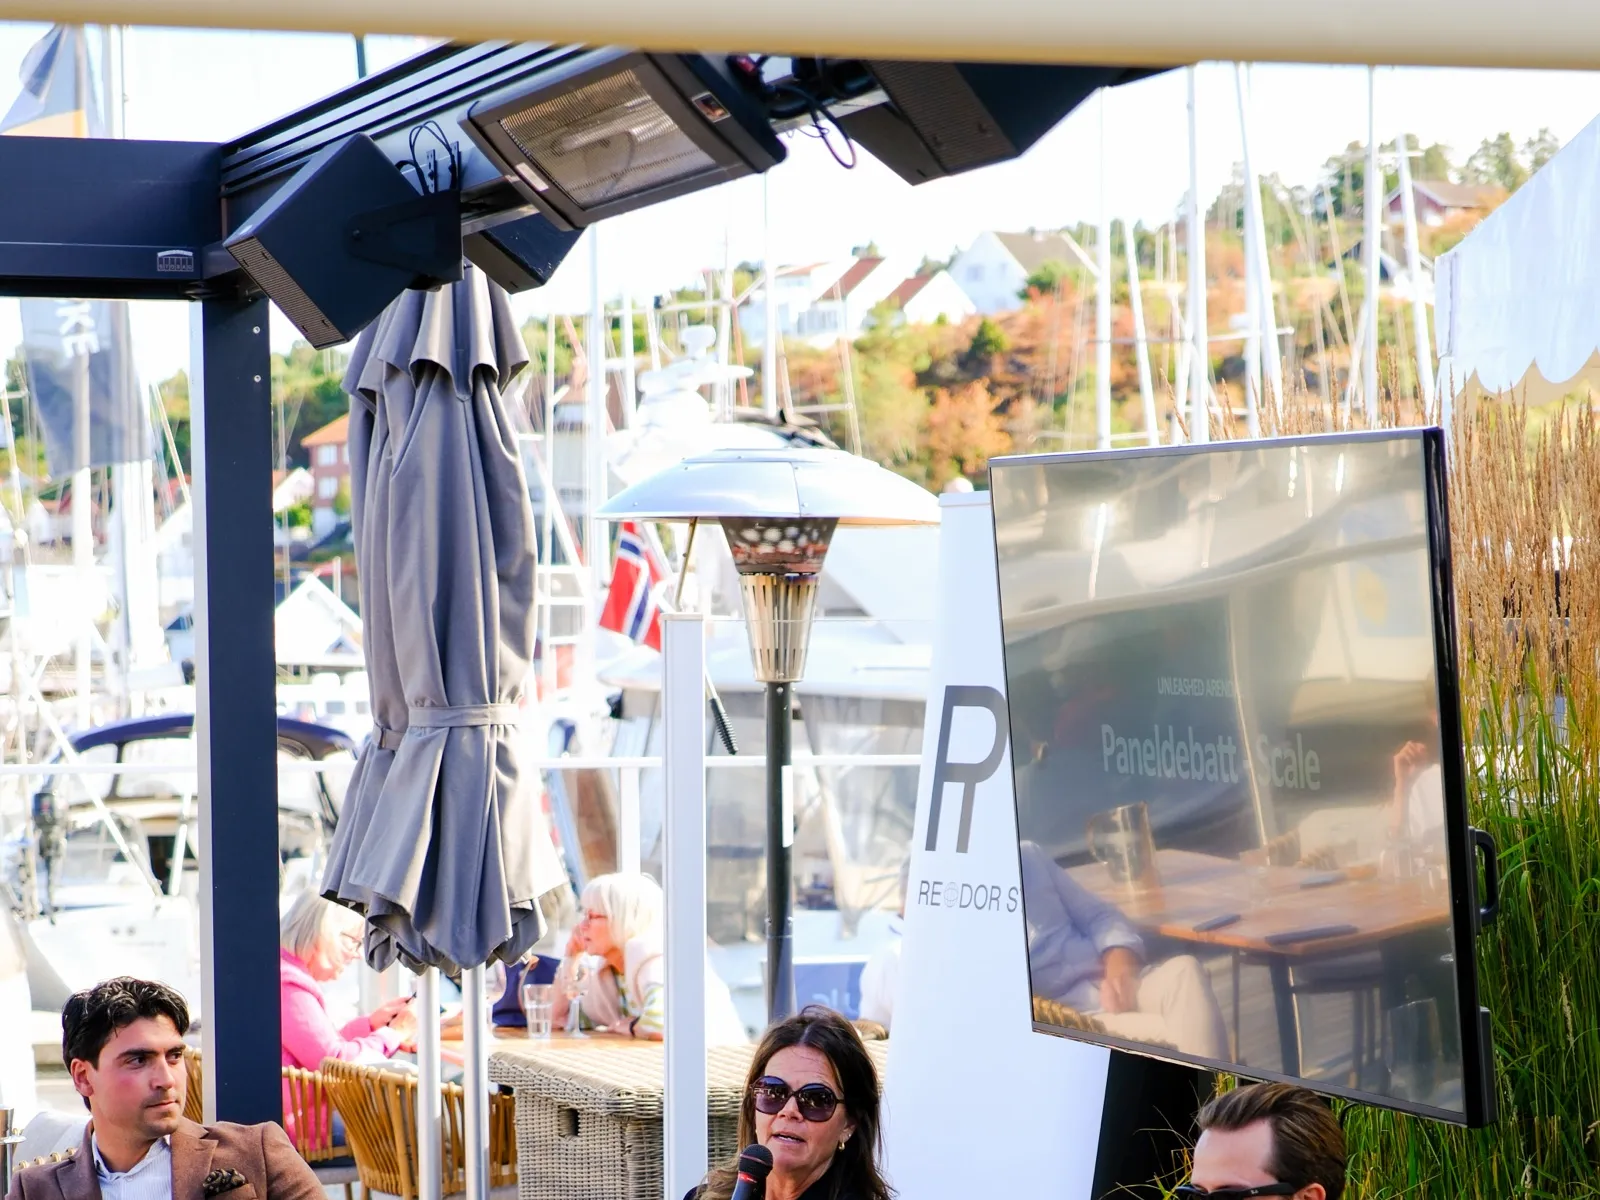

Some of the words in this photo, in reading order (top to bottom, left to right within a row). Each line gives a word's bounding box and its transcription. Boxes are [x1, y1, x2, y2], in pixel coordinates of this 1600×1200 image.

[56, 300, 100, 358] KE
[1157, 676, 1204, 697] UNLEASHED
[1100, 723, 1239, 784] Paneldebatt
[1257, 732, 1321, 791] Scale
